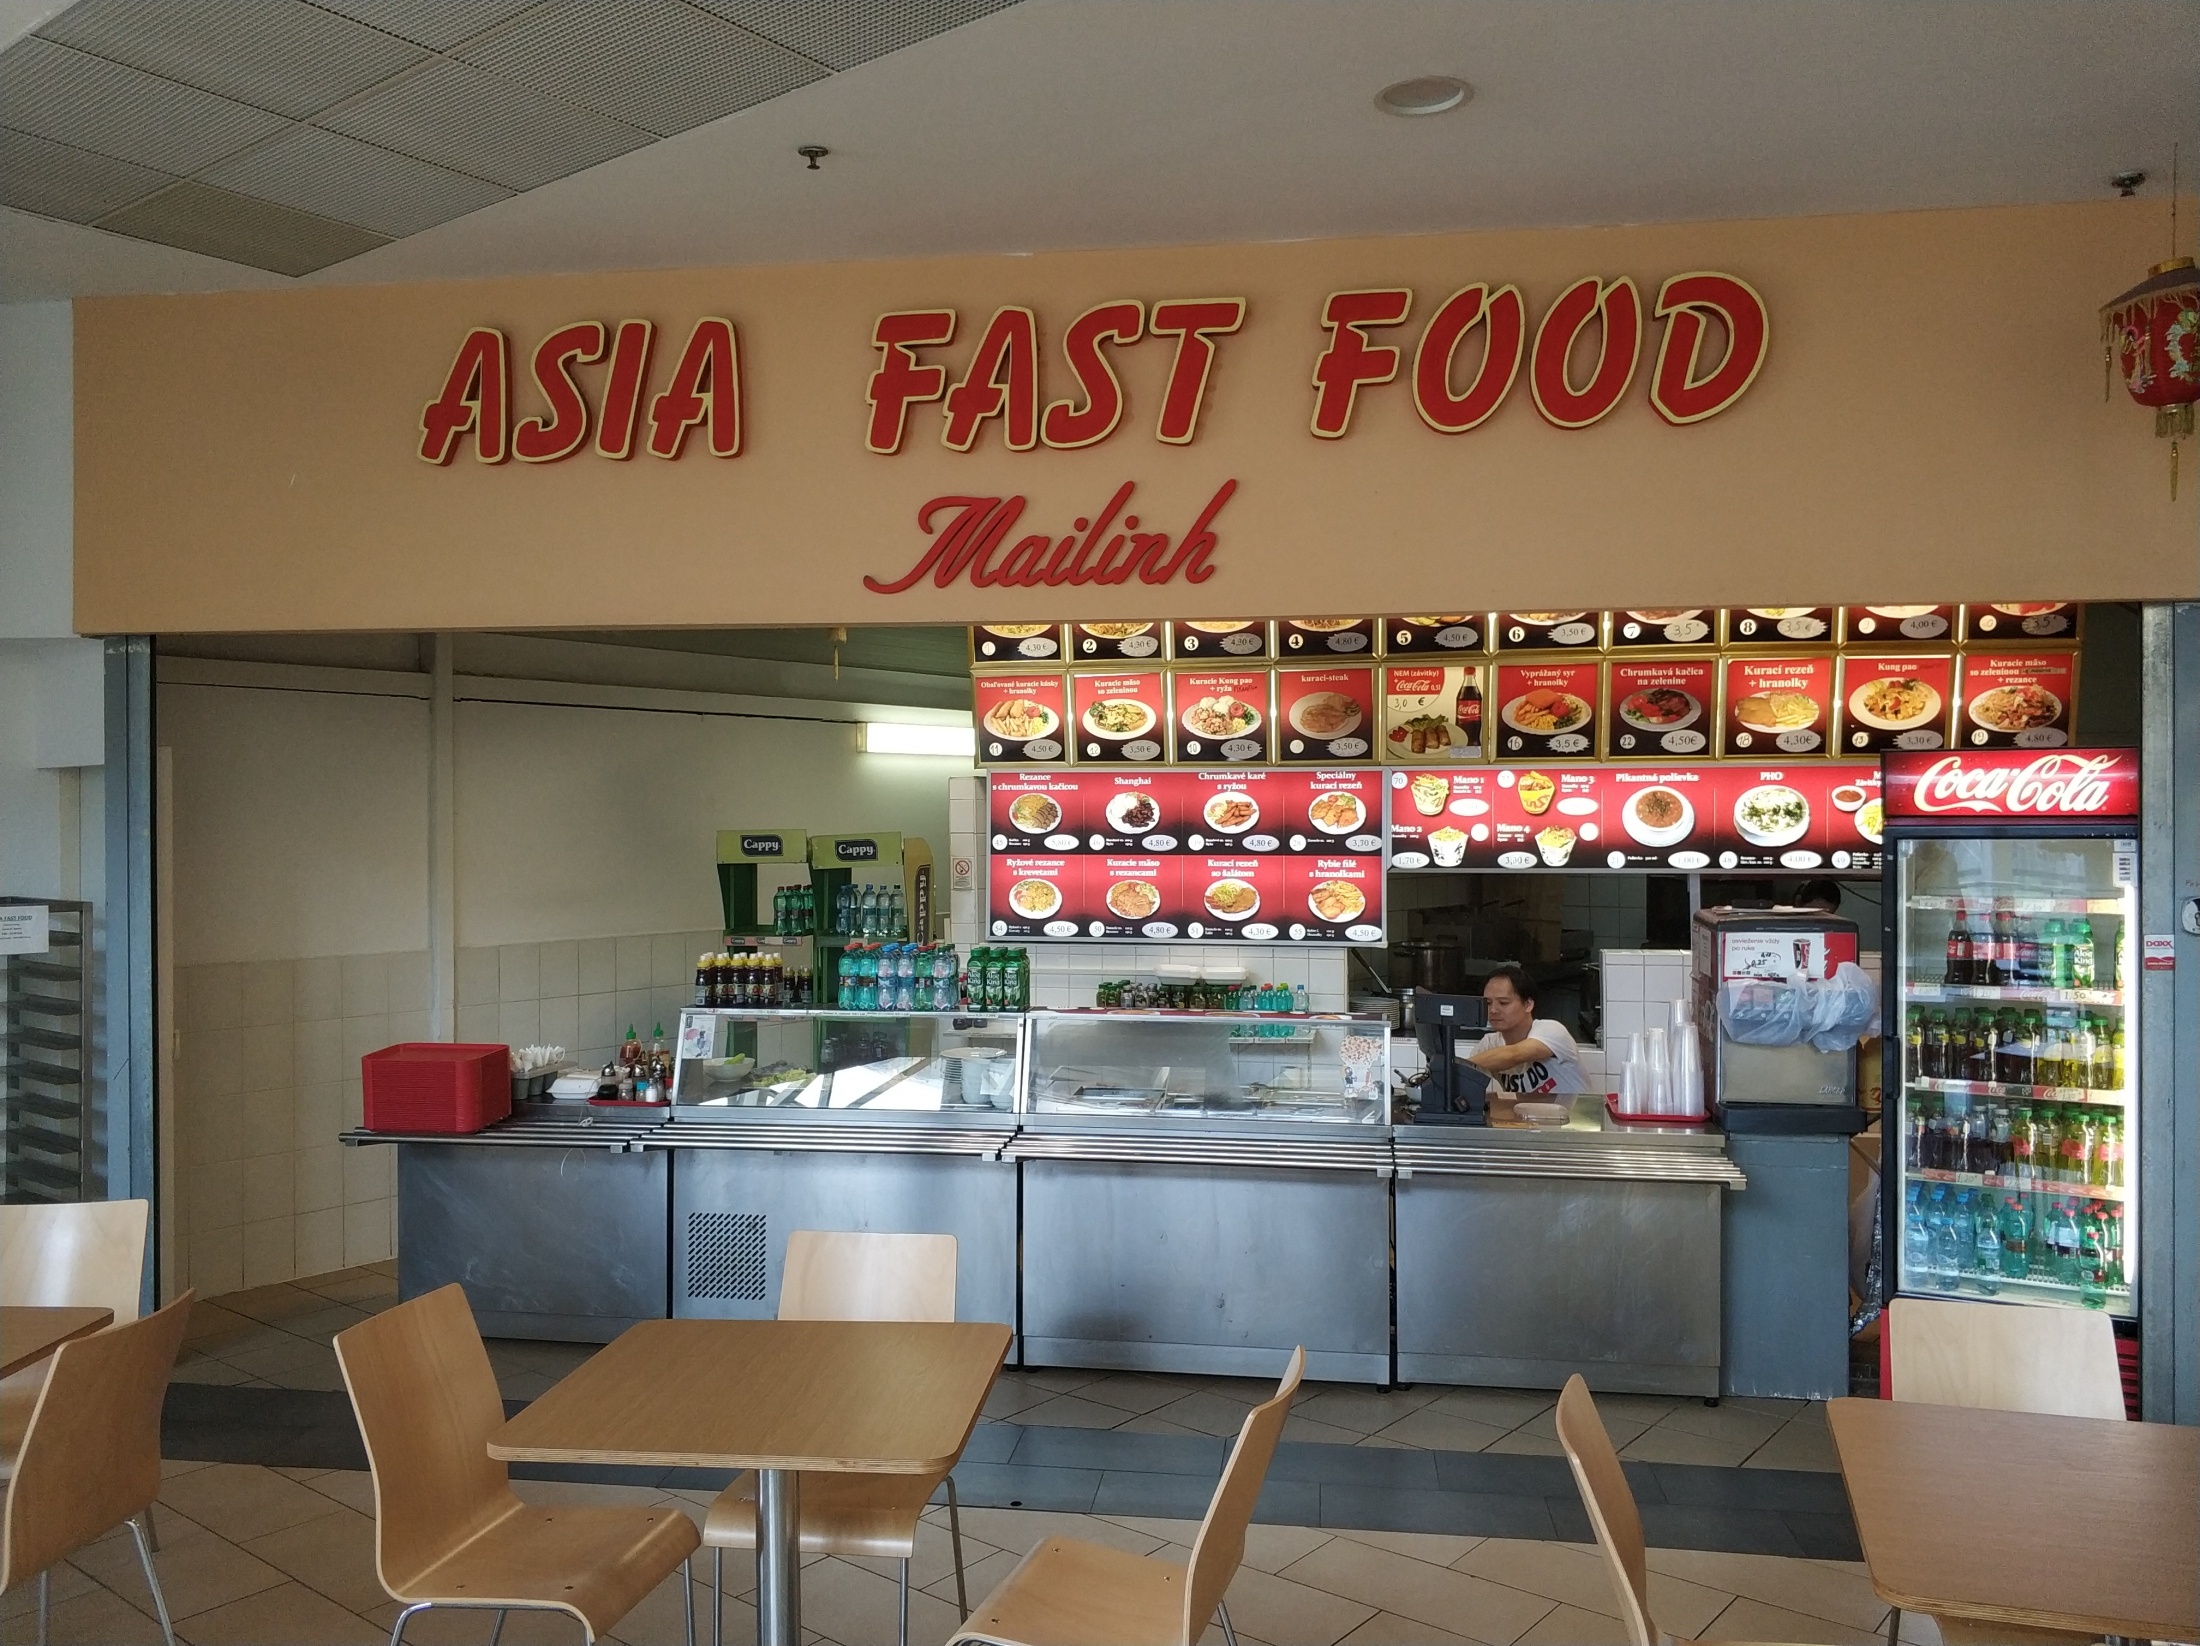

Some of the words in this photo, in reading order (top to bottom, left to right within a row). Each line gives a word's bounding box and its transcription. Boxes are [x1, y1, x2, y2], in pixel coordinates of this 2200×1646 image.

[417, 316, 743, 466] ASIA
[864, 296, 1245, 454] FAST
[1310, 271, 1770, 439] FOOD
[863, 478, 1238, 594] Mailinh
[1743, 621, 1752, 632] 8
[1910, 618, 1928, 630] 4,00
[1512, 629, 1522, 641] 6
[1561, 628, 1579, 639] 3,50
[1628, 625, 1636, 637] 7
[1290, 635, 1300, 646] 4
[1399, 630, 1409, 644] 5
[1443, 634, 1460, 644] 4,50
[1025, 642, 1041, 653] 4,30
[1085, 640, 1095, 652] 2
[1187, 638, 1196, 649] 3
[1877, 662, 1901, 675] Kung
[1901, 663, 1918, 674] pao
[1989, 659, 2023, 668] Kuracie
[1393, 669, 1409, 678] NEM
[1410, 669, 1440, 679] (závitky)
[1520, 669, 1562, 680] Vyprážaný
[1563, 669, 1576, 679] syr
[1620, 667, 1674, 678] Chrumkavá
[1674, 667, 1704, 678] kačica
[1744, 664, 1783, 676] Kurací
[1784, 664, 1814, 676] rezeň
[1969, 668, 1980, 677] so
[1980, 667, 2020, 677] zeleninou
[1094, 678, 1122, 688] Kuracie
[1122, 678, 1141, 687] mäso
[1189, 677, 1217, 687] Kuracie
[1218, 676, 1238, 688] Kung
[1239, 678, 1253, 688] pao
[1301, 673, 1350, 683] kuraci-steak
[1637, 678, 1649, 687] na
[1650, 676, 1687, 687] zelenine
[1759, 677, 1809, 690] hranolky
[2005, 675, 2038, 685] rezance
[1015, 680, 1039, 689] kuracie
[1107, 686, 1138, 695] zeleninou
[1336, 741, 1353, 752] 3,50
[1555, 738, 1571, 751] 3,5
[1620, 736, 1633, 747] 22
[1667, 735, 1698, 747] 4,50€
[1783, 735, 1813, 747] 4,30€
[1906, 735, 1925, 747] 3,30
[1031, 745, 1046, 755] 4,50
[1019, 772, 1052, 782] Rezance
[1114, 776, 1152, 787] Shanghai
[1198, 771, 1247, 782] Chrumkavé
[1247, 771, 1267, 781] karé
[1316, 771, 1358, 783] Speciálny
[1452, 774, 1478, 785] Mano
[1561, 773, 1587, 783] Mano
[1588, 775, 1595, 784] 3
[1615, 772, 1658, 784] Pikantná
[1659, 772, 1700, 784] polievka
[1759, 771, 1783, 781] PHO
[992, 783, 997, 791] s
[997, 782, 1048, 792] chrumkavou
[1048, 781, 1079, 791] kačicou
[1217, 782, 1222, 791] s
[1222, 781, 1247, 792] ryžou
[1310, 780, 1339, 791] kurací
[1338, 780, 1364, 791] rezeň
[1391, 823, 1415, 833] Mano
[1497, 823, 1522, 833] Mano
[1523, 825, 1531, 834] 4
[743, 839, 782, 852] Cappy
[1148, 838, 1165, 849] 4,80
[1166, 838, 1173, 847] €
[1249, 838, 1266, 849] 4,80
[1267, 838, 1274, 848] €
[1352, 838, 1370, 849] 3,70
[1371, 838, 1377, 848] €
[837, 844, 876, 857] Cappy
[1006, 858, 1034, 869] Ryžové
[1034, 859, 1066, 868] rezance
[1106, 858, 1138, 868] Kuracie
[1138, 858, 1161, 868] mäso
[1207, 858, 1236, 868] Kurací
[1235, 858, 1260, 868] rezeň
[1317, 859, 1342, 870] Rybie
[1342, 858, 1358, 869] filé
[1397, 856, 1415, 867] 1,70
[1415, 856, 1423, 866] €
[1524, 855, 1531, 865] €
[1012, 869, 1017, 877] s
[1018, 867, 1059, 877] krevetami
[1109, 870, 1114, 878] s
[1115, 868, 1158, 878] rezancami
[1211, 870, 1221, 878] so
[1221, 868, 1256, 878] šalátom
[1308, 871, 1314, 879] s
[1049, 925, 1066, 935] 4,50
[1148, 925, 1165, 936] 4,80
[1166, 925, 1173, 935] €
[1248, 926, 1266, 937] 4,30
[1352, 928, 1370, 938] 4,50
[1371, 928, 1378, 938] €
[1500, 1073, 1527, 1093] UST
[1526, 1061, 1549, 1089] DO
